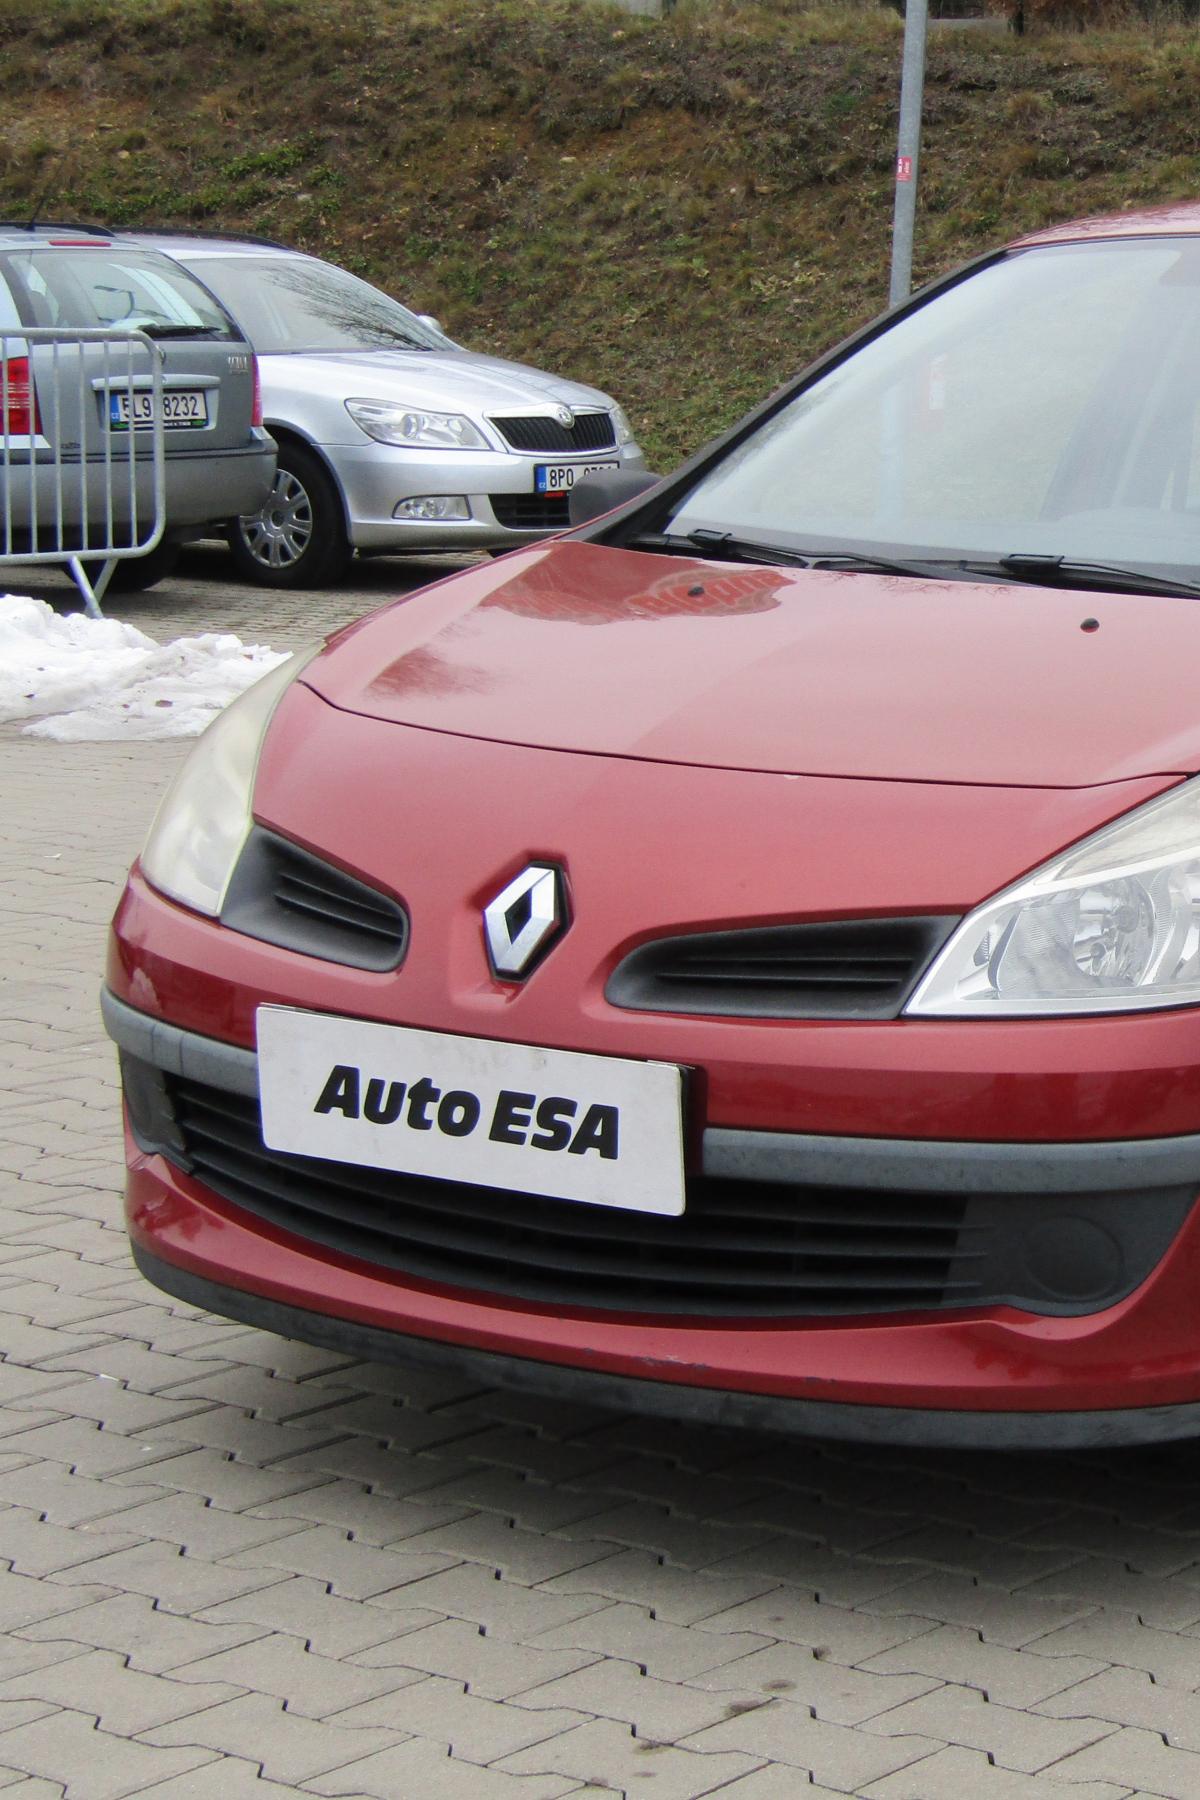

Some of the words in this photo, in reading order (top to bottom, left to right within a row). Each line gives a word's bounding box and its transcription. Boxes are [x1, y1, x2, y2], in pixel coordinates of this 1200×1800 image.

[122, 397, 152, 418] 5L9
[163, 396, 199, 417] 8232
[313, 1064, 480, 1137] Auto
[488, 1089, 619, 1160] ESA
